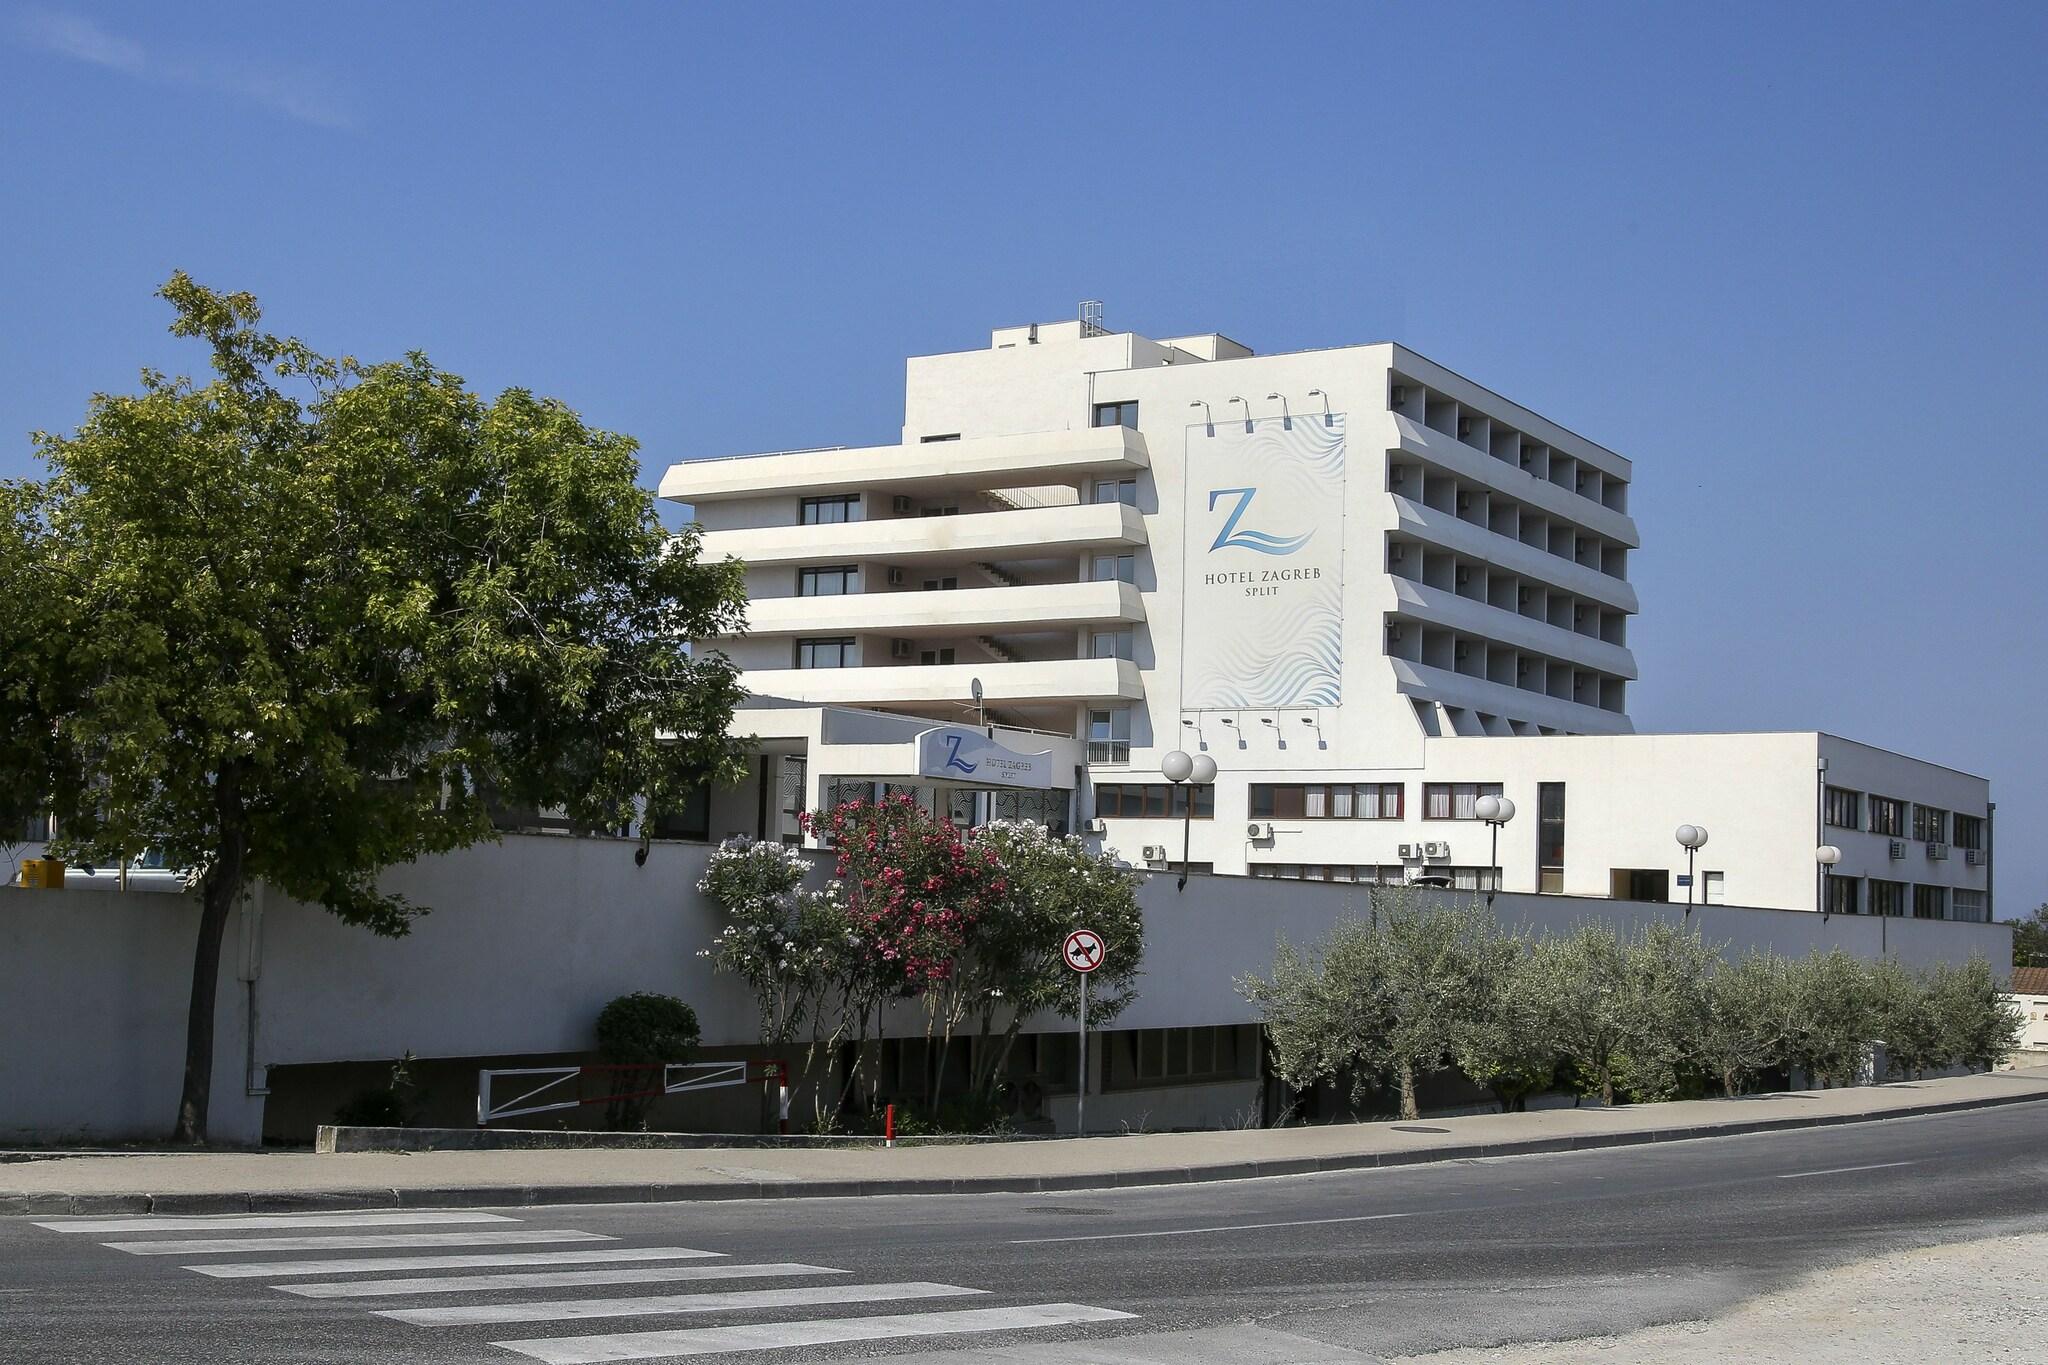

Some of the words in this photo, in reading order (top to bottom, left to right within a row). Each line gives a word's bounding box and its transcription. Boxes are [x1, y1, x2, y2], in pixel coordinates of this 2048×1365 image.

[1205, 571, 1255, 585] HOTEL
[1261, 567, 1321, 582] ZAGREB
[1245, 586, 1279, 597] SPLIT
[946, 735, 979, 774] Z
[986, 757, 1007, 769] HOTEL
[1007, 760, 1032, 771] ZAGREB
